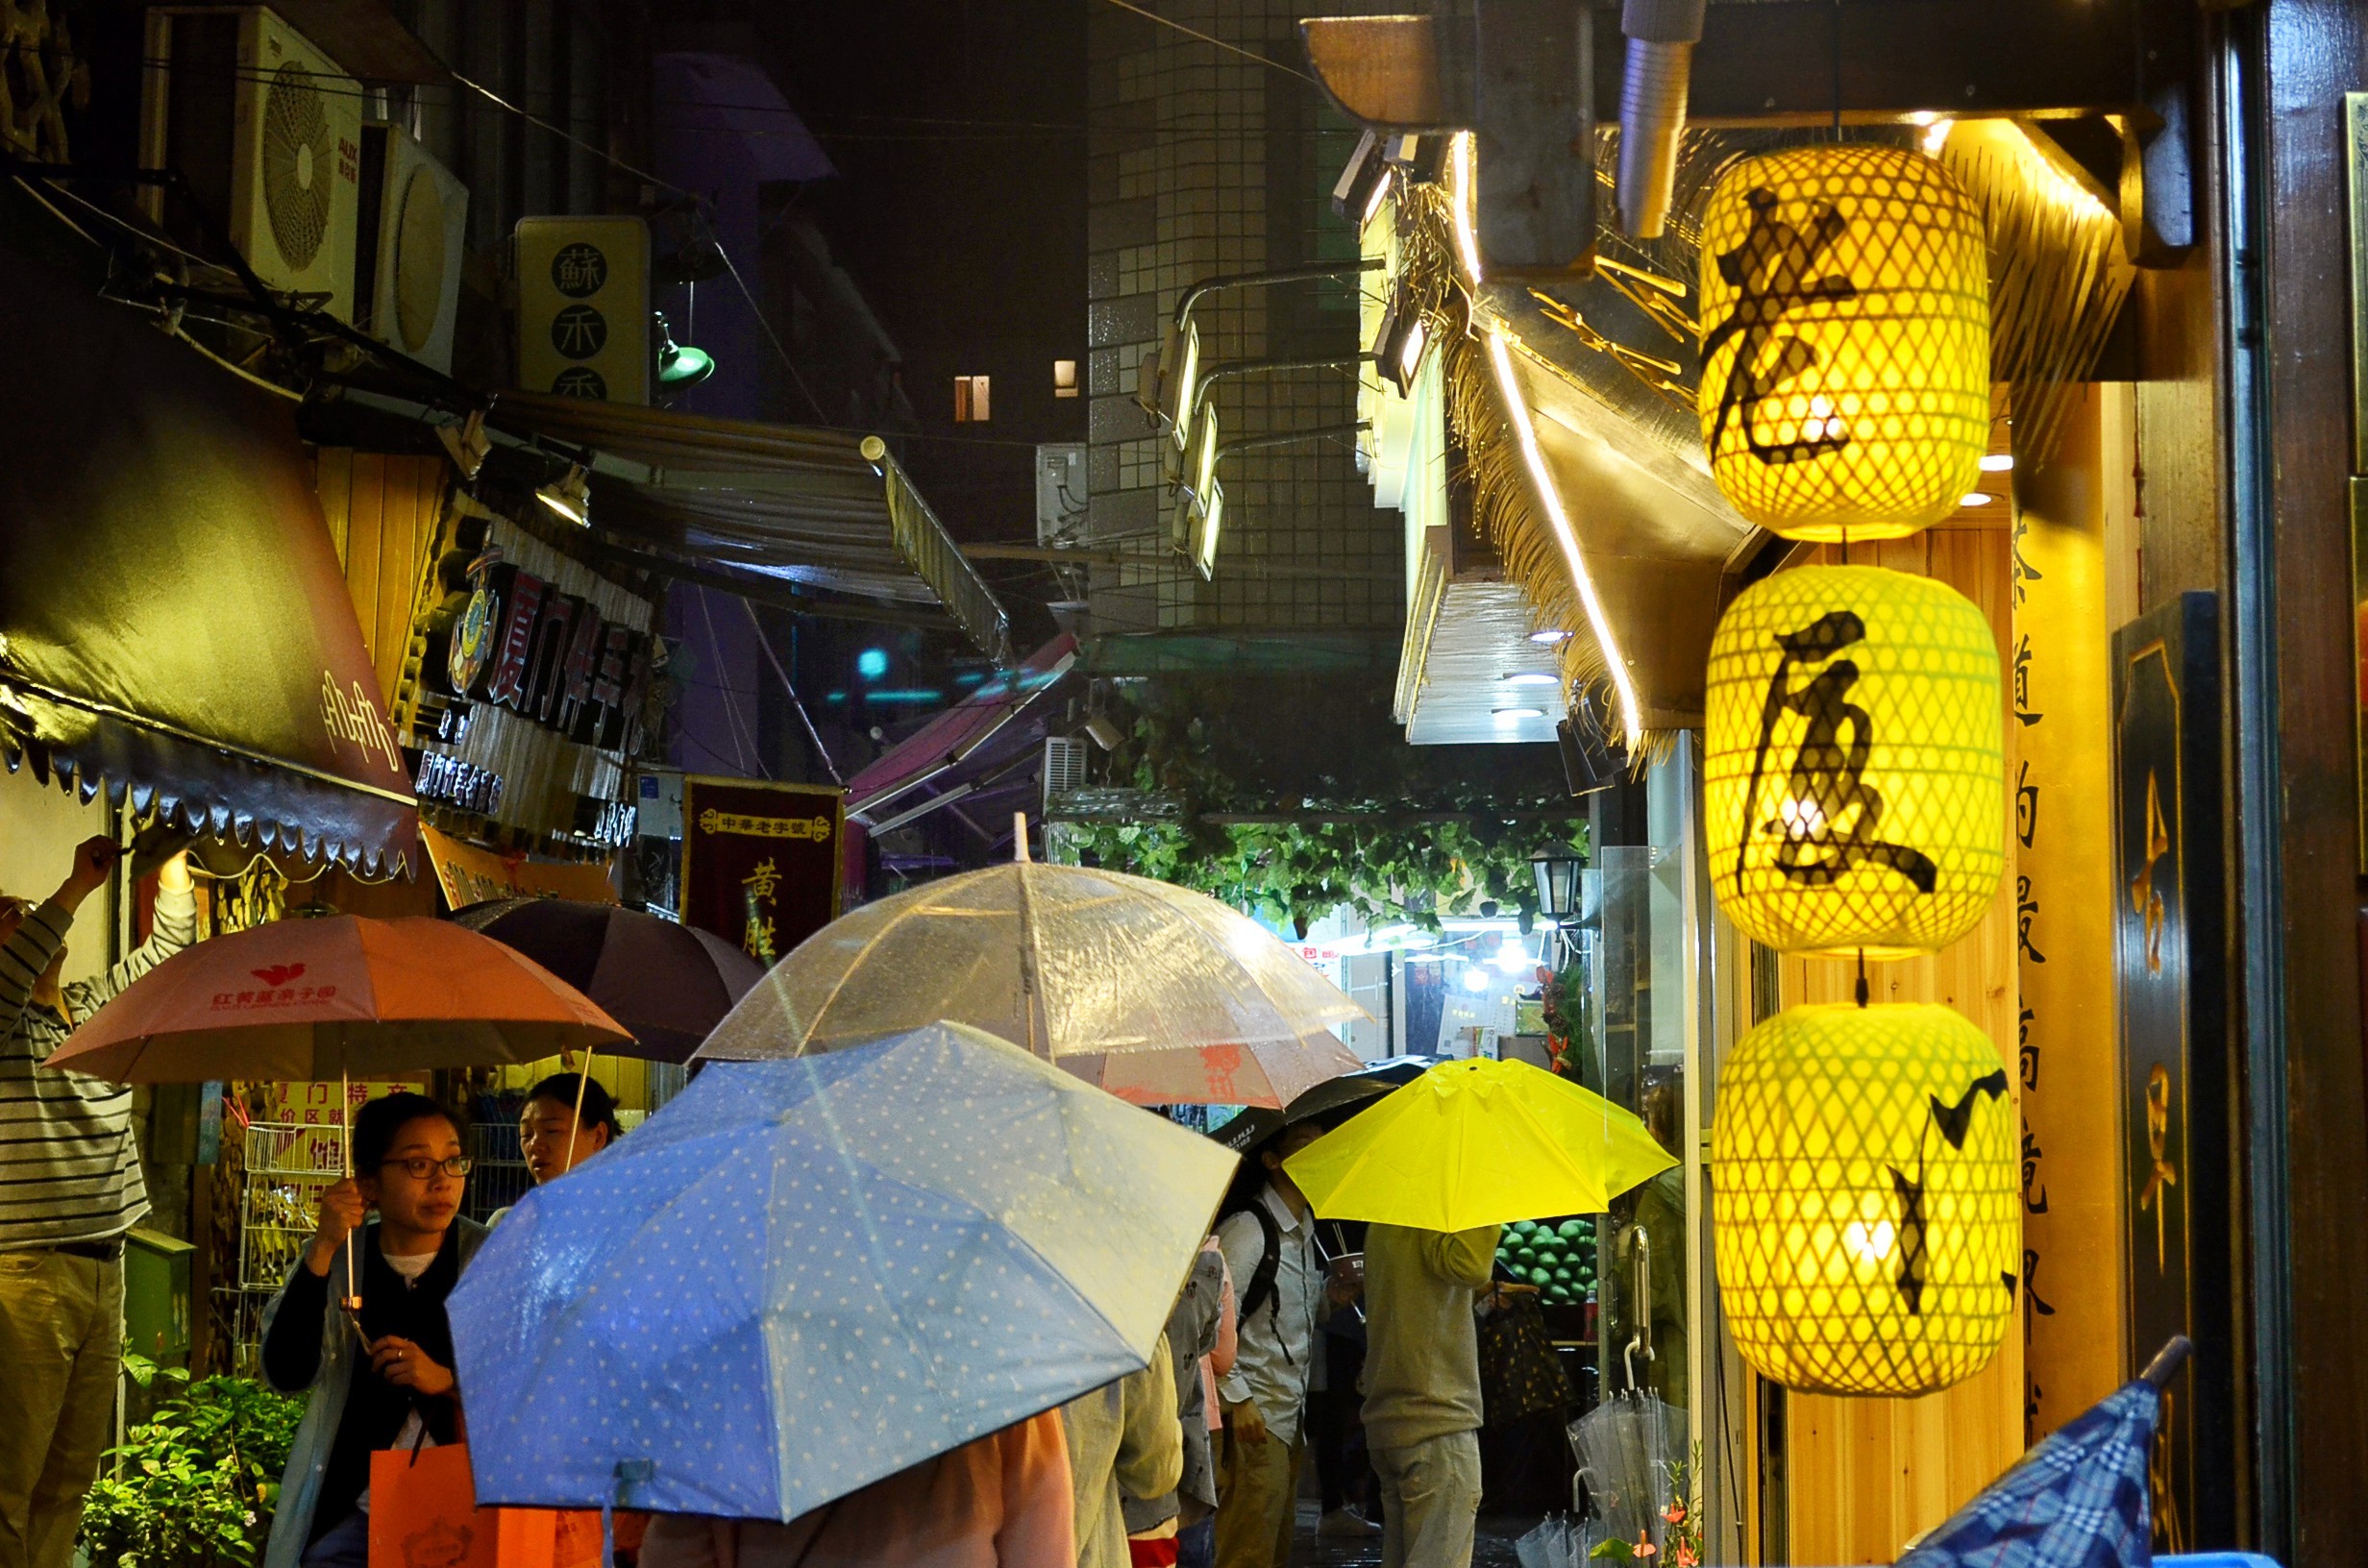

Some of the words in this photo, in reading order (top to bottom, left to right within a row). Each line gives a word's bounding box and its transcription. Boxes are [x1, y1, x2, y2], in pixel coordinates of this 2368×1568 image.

[338, 137, 358, 162] AUX
[722, 816, 807, 836] 中華老字號
[740, 856, 783, 958] 黄胜
